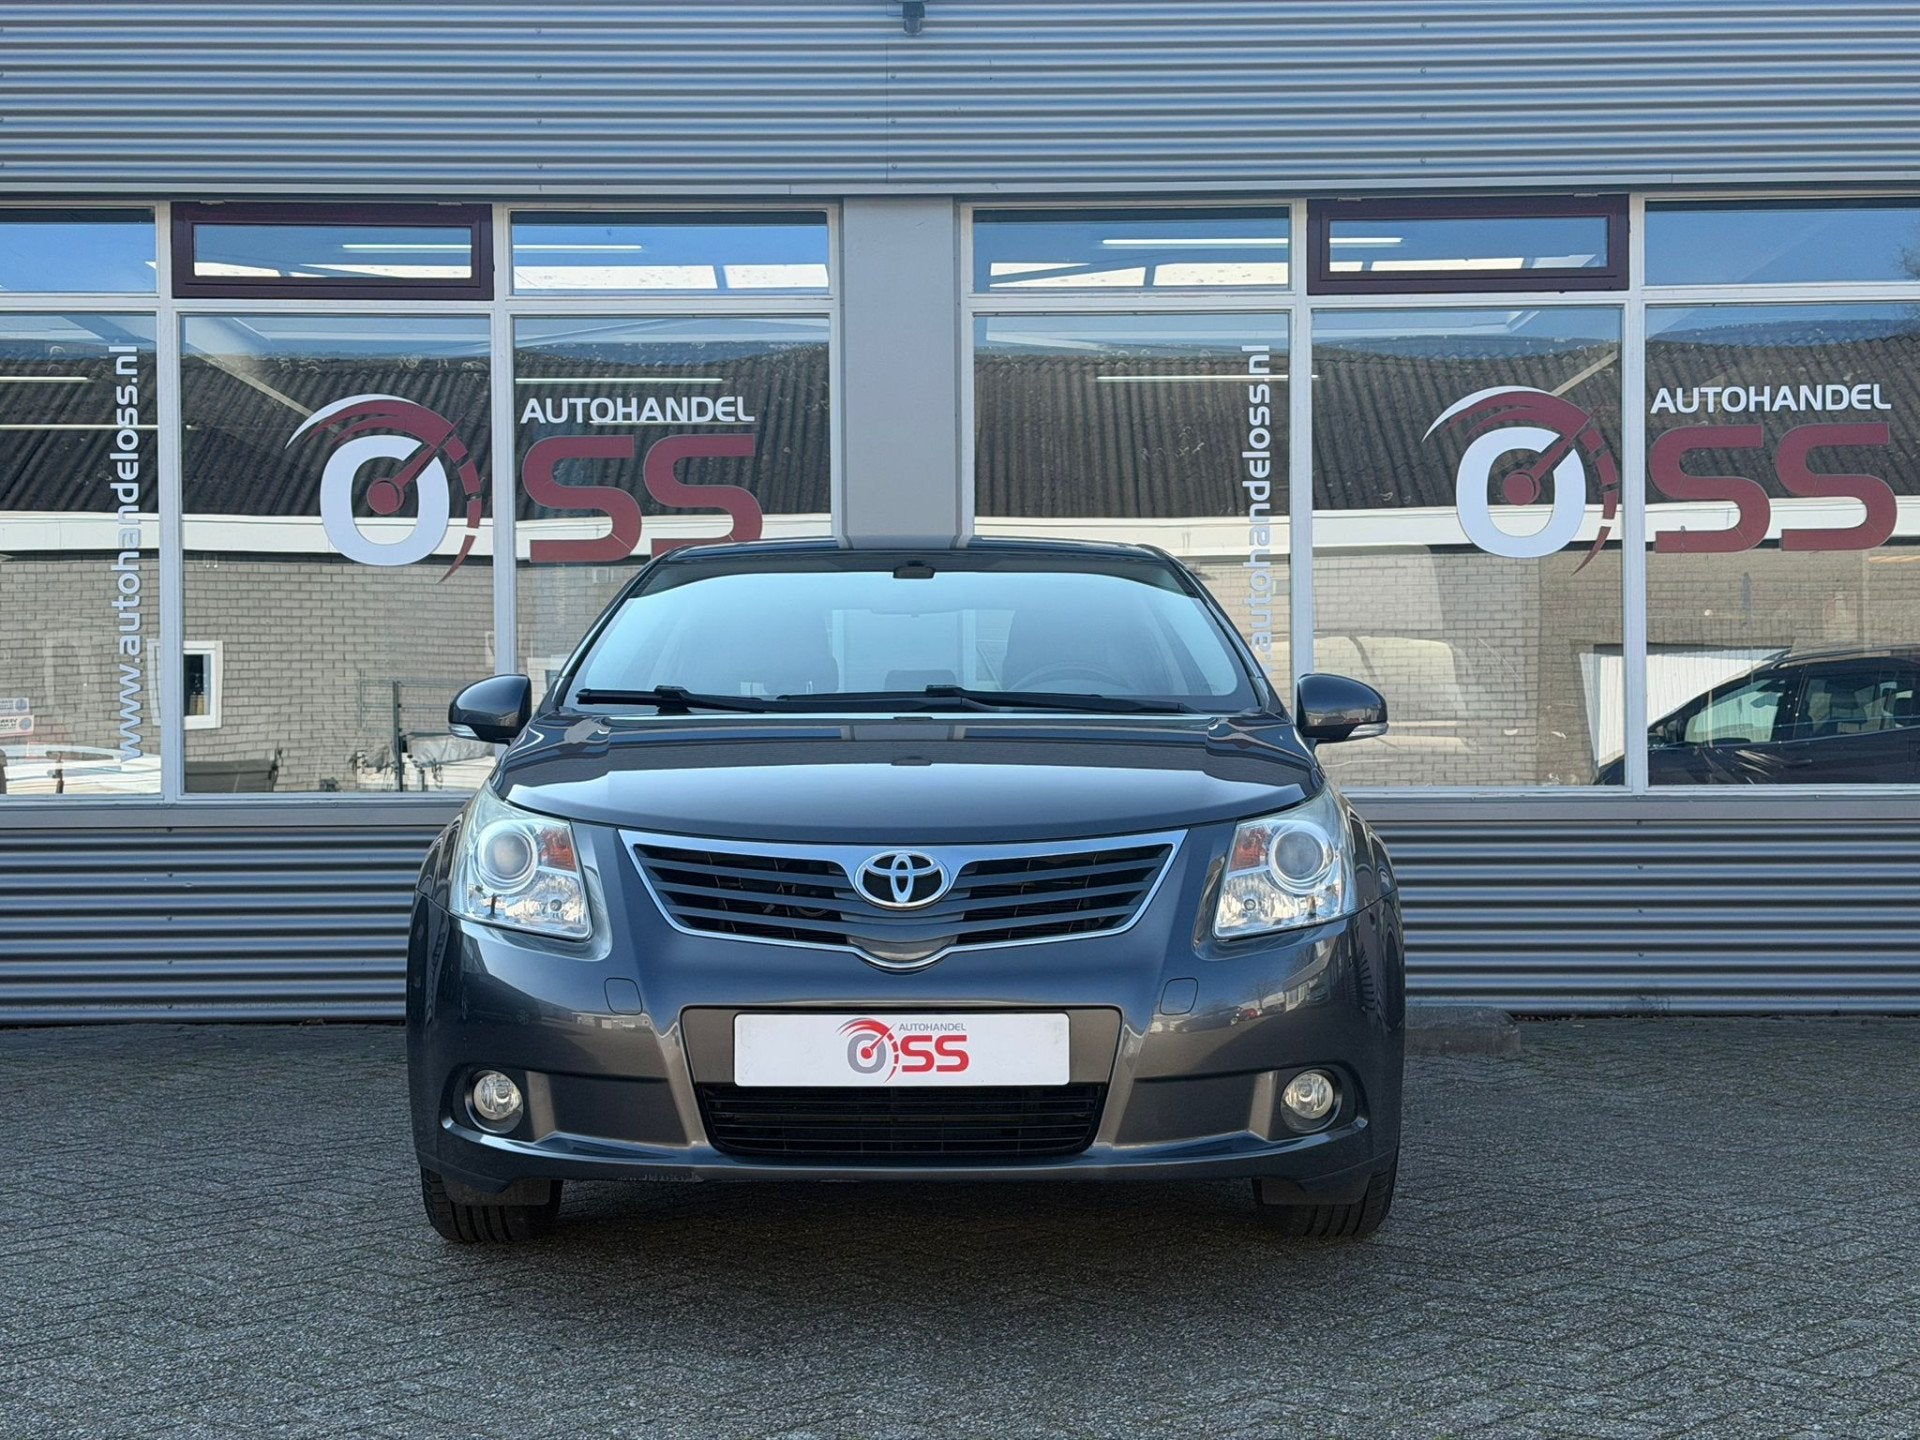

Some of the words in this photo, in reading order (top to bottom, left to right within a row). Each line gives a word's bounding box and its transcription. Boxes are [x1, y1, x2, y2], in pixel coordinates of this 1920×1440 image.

[520, 396, 756, 424] AUTOHANDEL
[1650, 383, 1892, 414] AUTOHANDEL
[1241, 344, 1274, 676] .autohandeloss.nl
[1455, 423, 1898, 558] OSS
[109, 345, 143, 763] www.autohandeloss.nl
[898, 1022, 967, 1032] AUTOHANDEL
[847, 1033, 969, 1074] OSS
